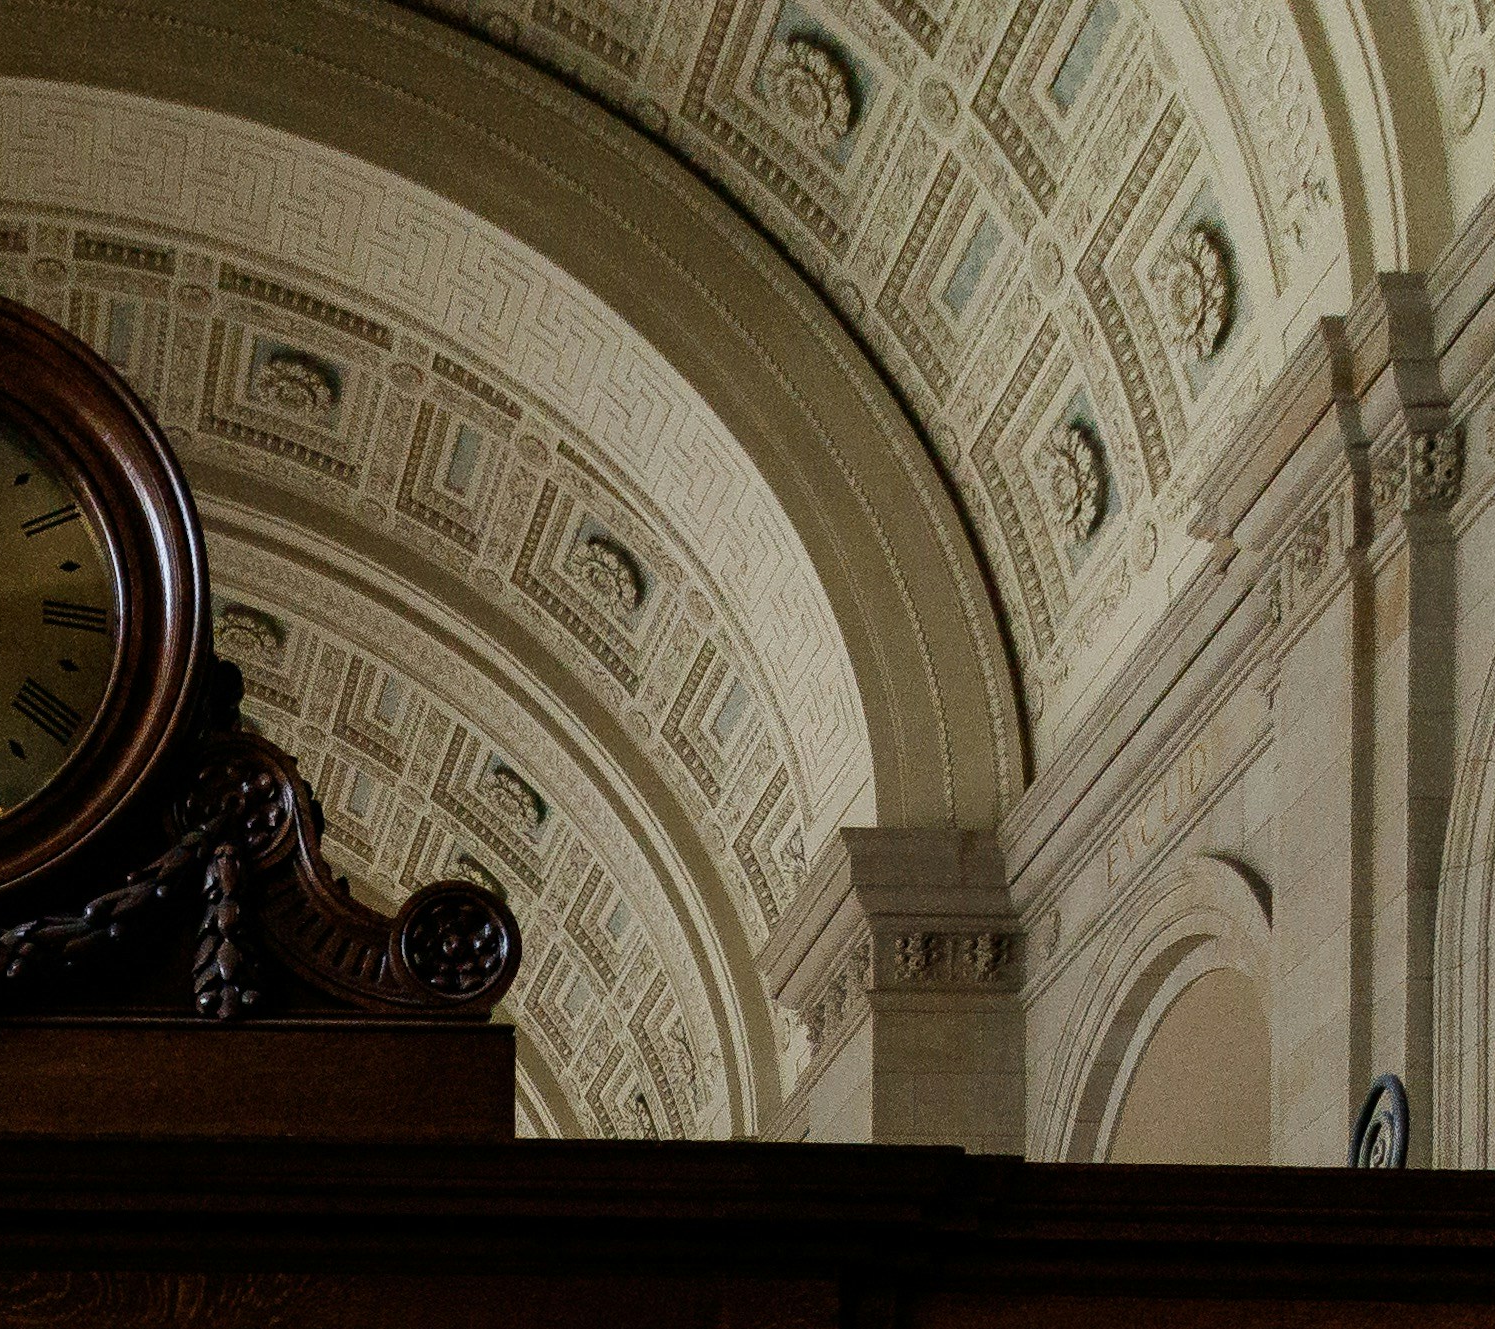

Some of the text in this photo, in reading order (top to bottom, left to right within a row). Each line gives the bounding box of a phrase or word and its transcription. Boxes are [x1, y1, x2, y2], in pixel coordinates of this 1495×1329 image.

[21, 503, 82, 538] II
[43, 599, 108, 634] III
[11, 676, 83, 747] IIII
